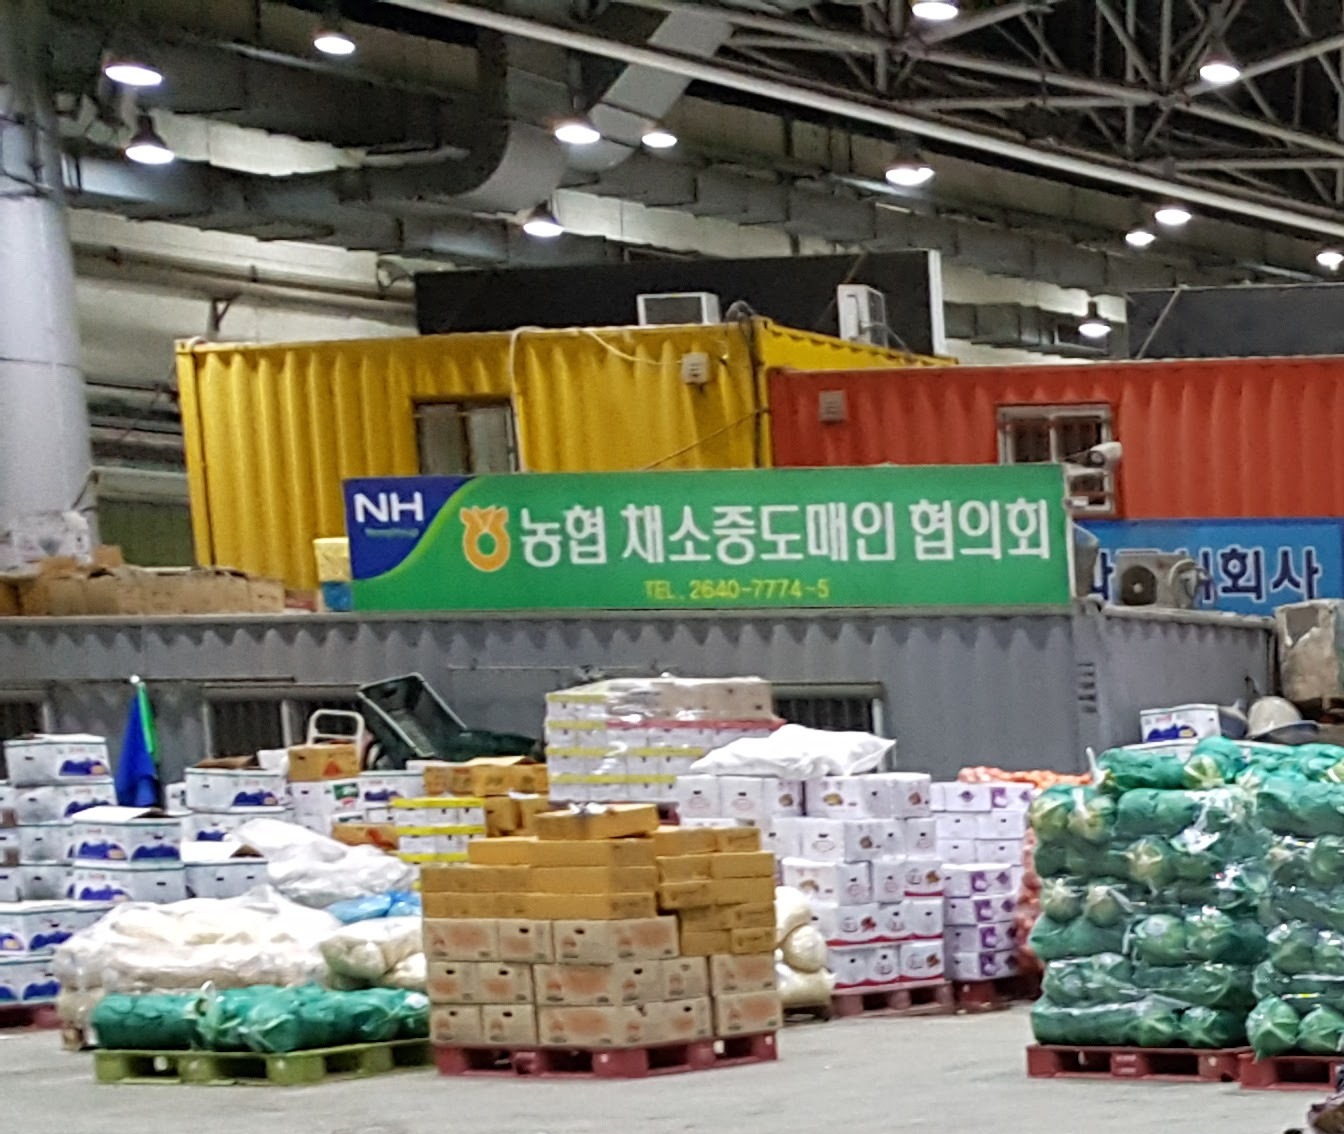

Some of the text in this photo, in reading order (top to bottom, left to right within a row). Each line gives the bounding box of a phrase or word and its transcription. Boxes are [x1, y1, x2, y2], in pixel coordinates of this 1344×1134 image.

[353, 492, 423, 523] NH
[520, 497, 1051, 569] 농협 채소중도매인 협의회
